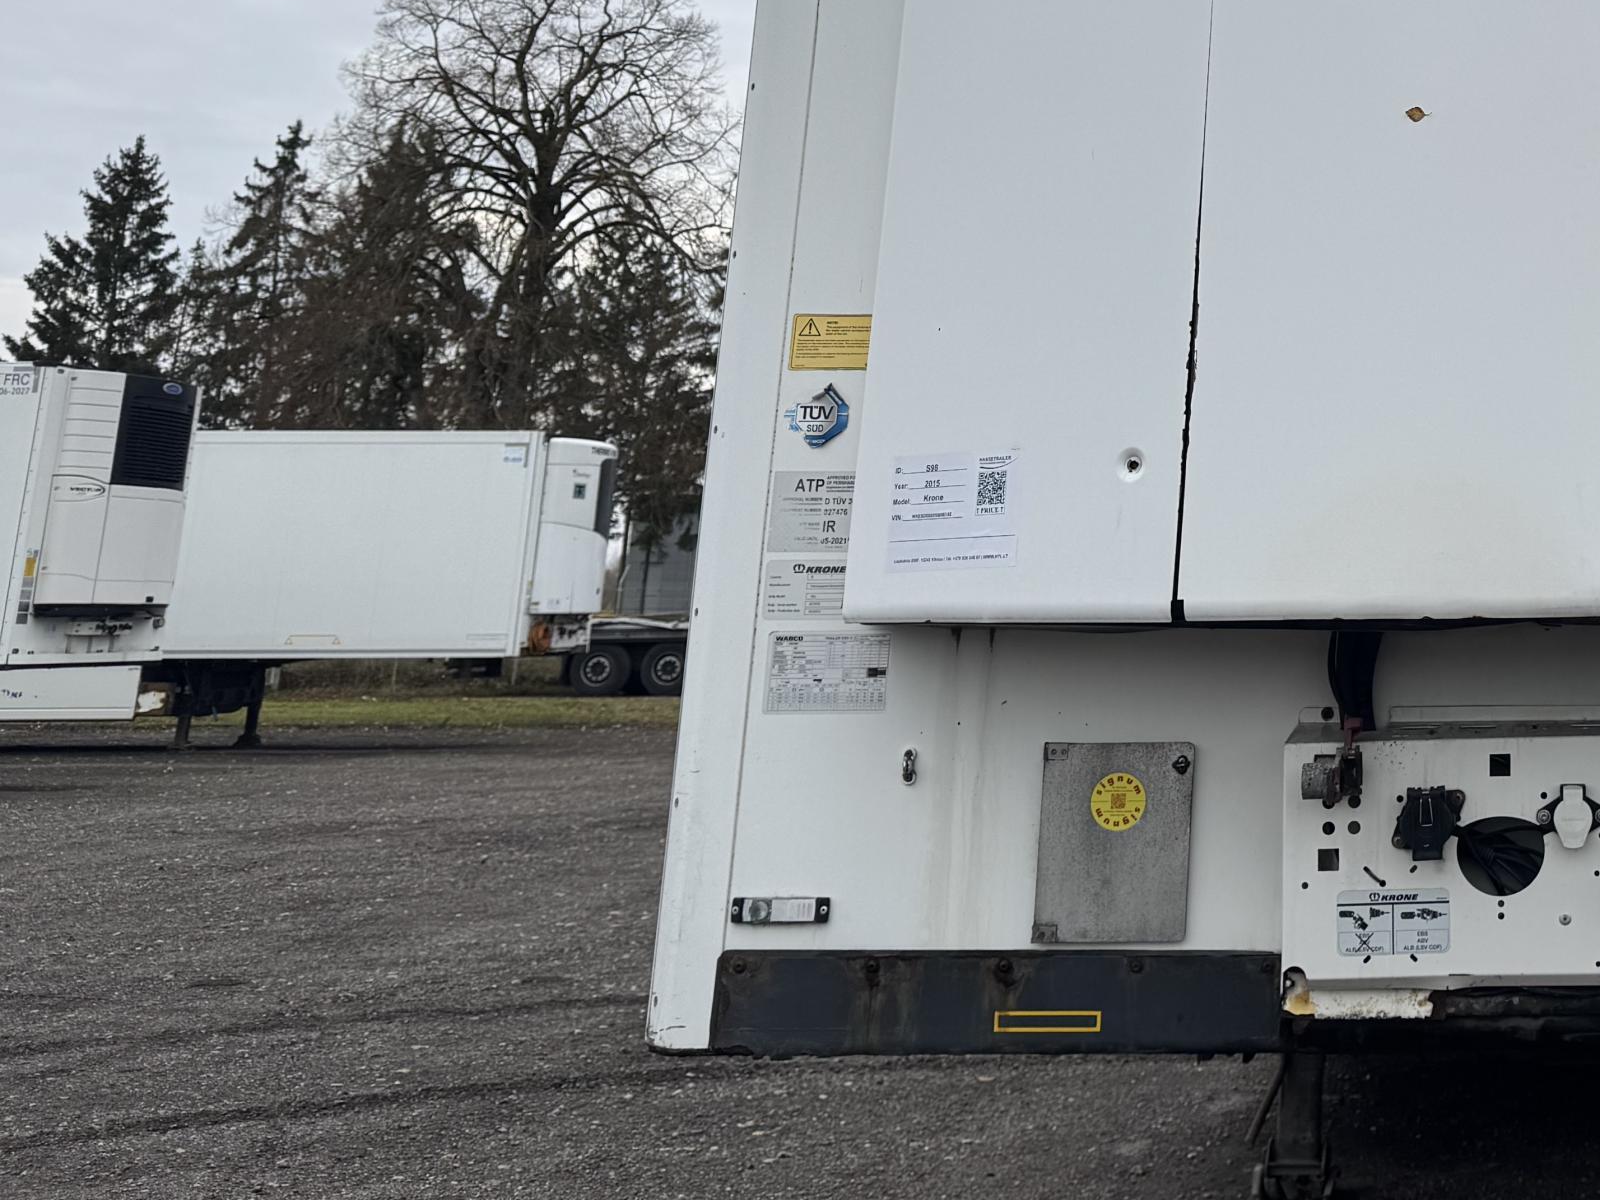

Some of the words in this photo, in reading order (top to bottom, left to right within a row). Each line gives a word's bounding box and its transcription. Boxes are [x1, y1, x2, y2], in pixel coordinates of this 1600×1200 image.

[3, 373, 31, 386] FRC
[799, 405, 836, 420] TÜV
[794, 478, 825, 492] ATP
[924, 480, 941, 489] 2015
[923, 494, 944, 502] Krone
[822, 520, 836, 533] IR
[806, 565, 847, 574] KRONE
[1381, 893, 1419, 901] KRONE
